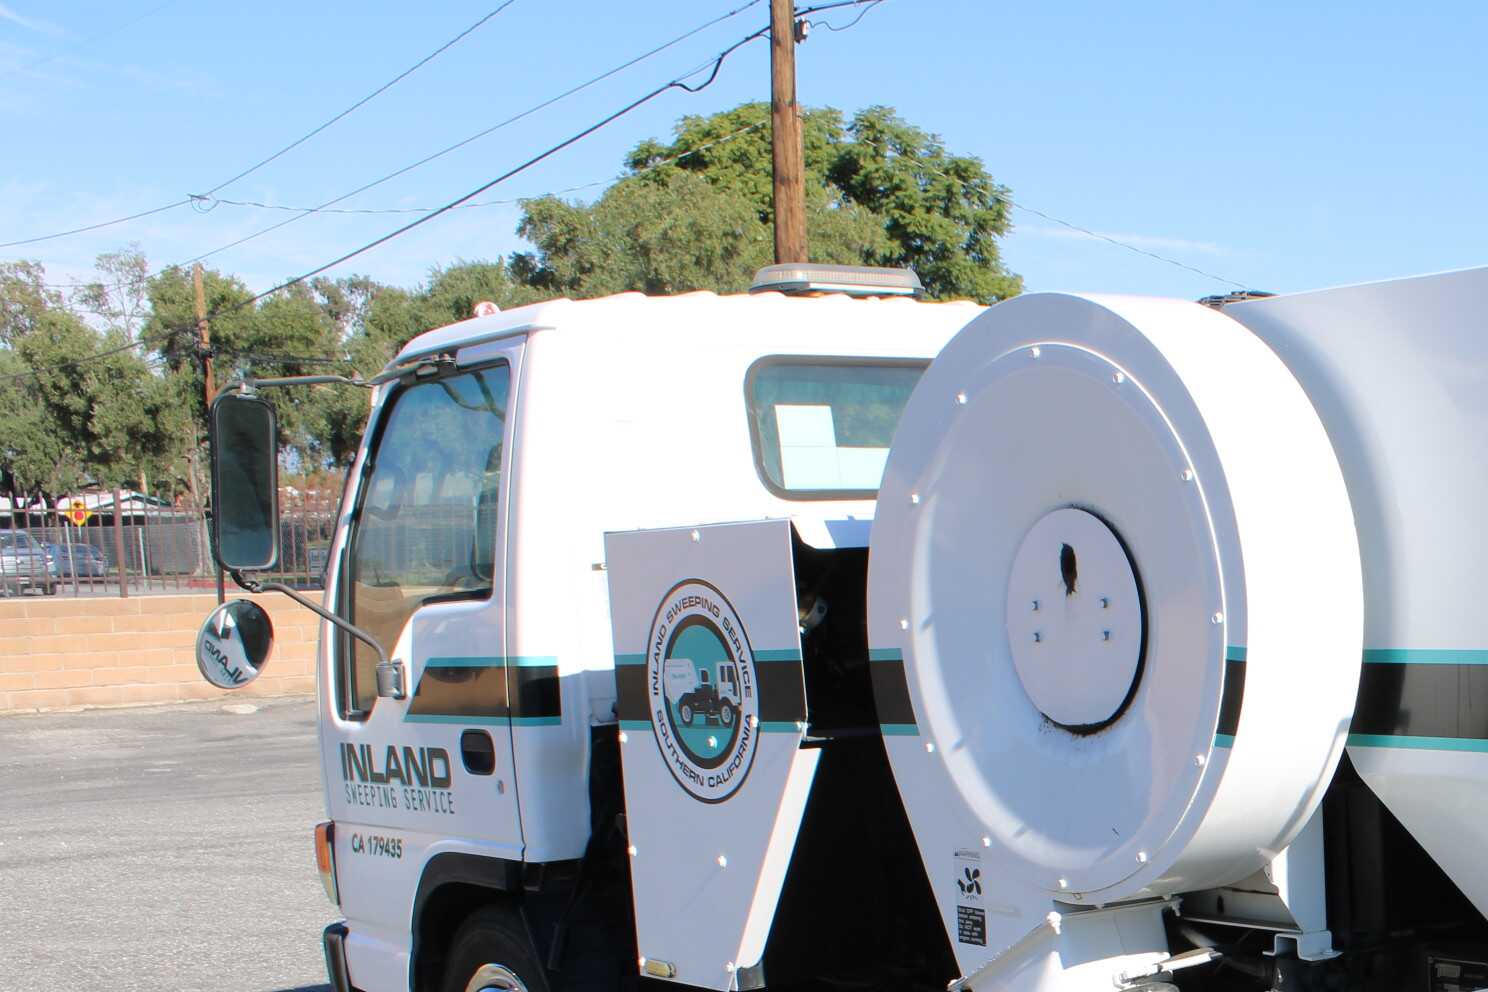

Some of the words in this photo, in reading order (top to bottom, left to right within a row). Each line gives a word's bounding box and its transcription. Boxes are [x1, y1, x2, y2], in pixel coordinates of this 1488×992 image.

[653, 624, 668, 697] INLAND
[666, 596, 721, 624] SWEEPING
[722, 617, 753, 698] SERVICE
[340, 742, 452, 788] INLAND
[657, 710, 705, 786] SOUTHERN
[707, 714, 753, 788] CALIFORNIA
[345, 783, 398, 809] SWEEPING
[403, 788, 455, 815] SERVICE
[351, 833, 366, 854] CA
[368, 835, 402, 859] 179435
